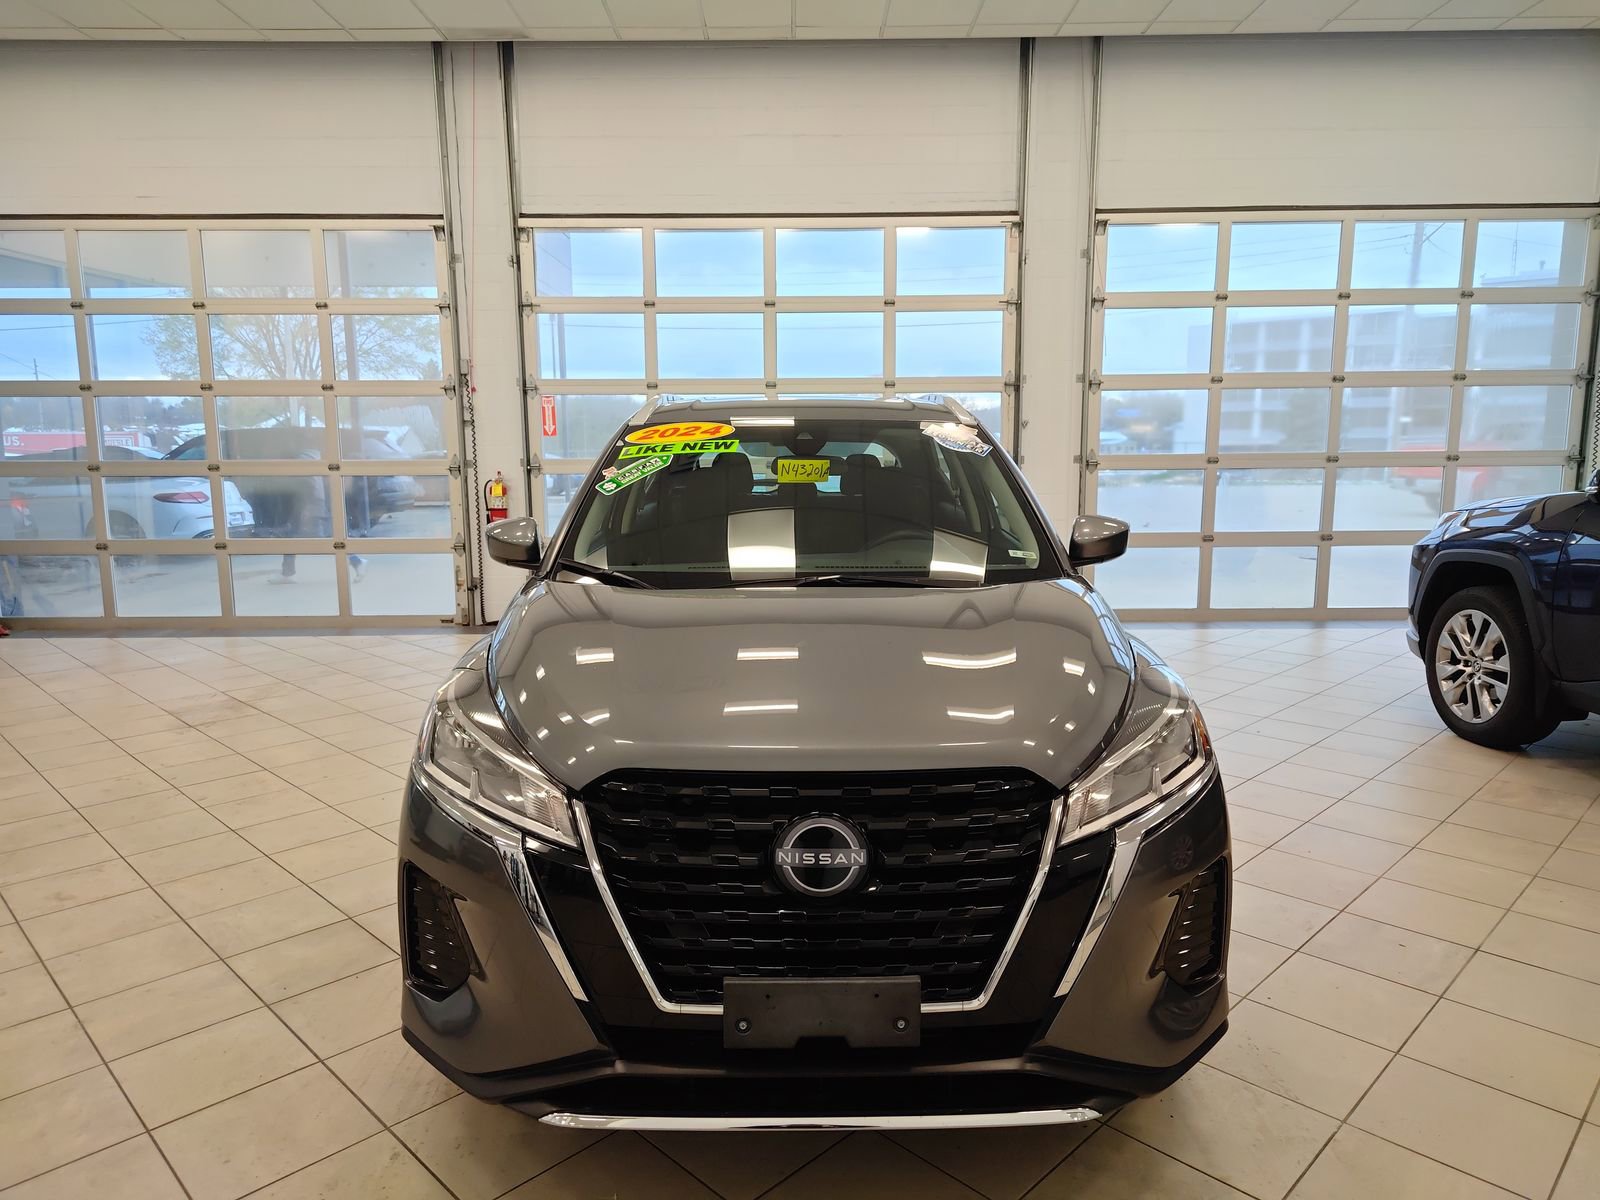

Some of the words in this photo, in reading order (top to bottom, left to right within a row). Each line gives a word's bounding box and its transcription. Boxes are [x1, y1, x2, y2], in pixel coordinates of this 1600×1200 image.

[637, 426, 723, 440] 2024
[621, 443, 675, 456] LIKE
[681, 441, 735, 452] NEW
[778, 851, 864, 865] NISSAN
